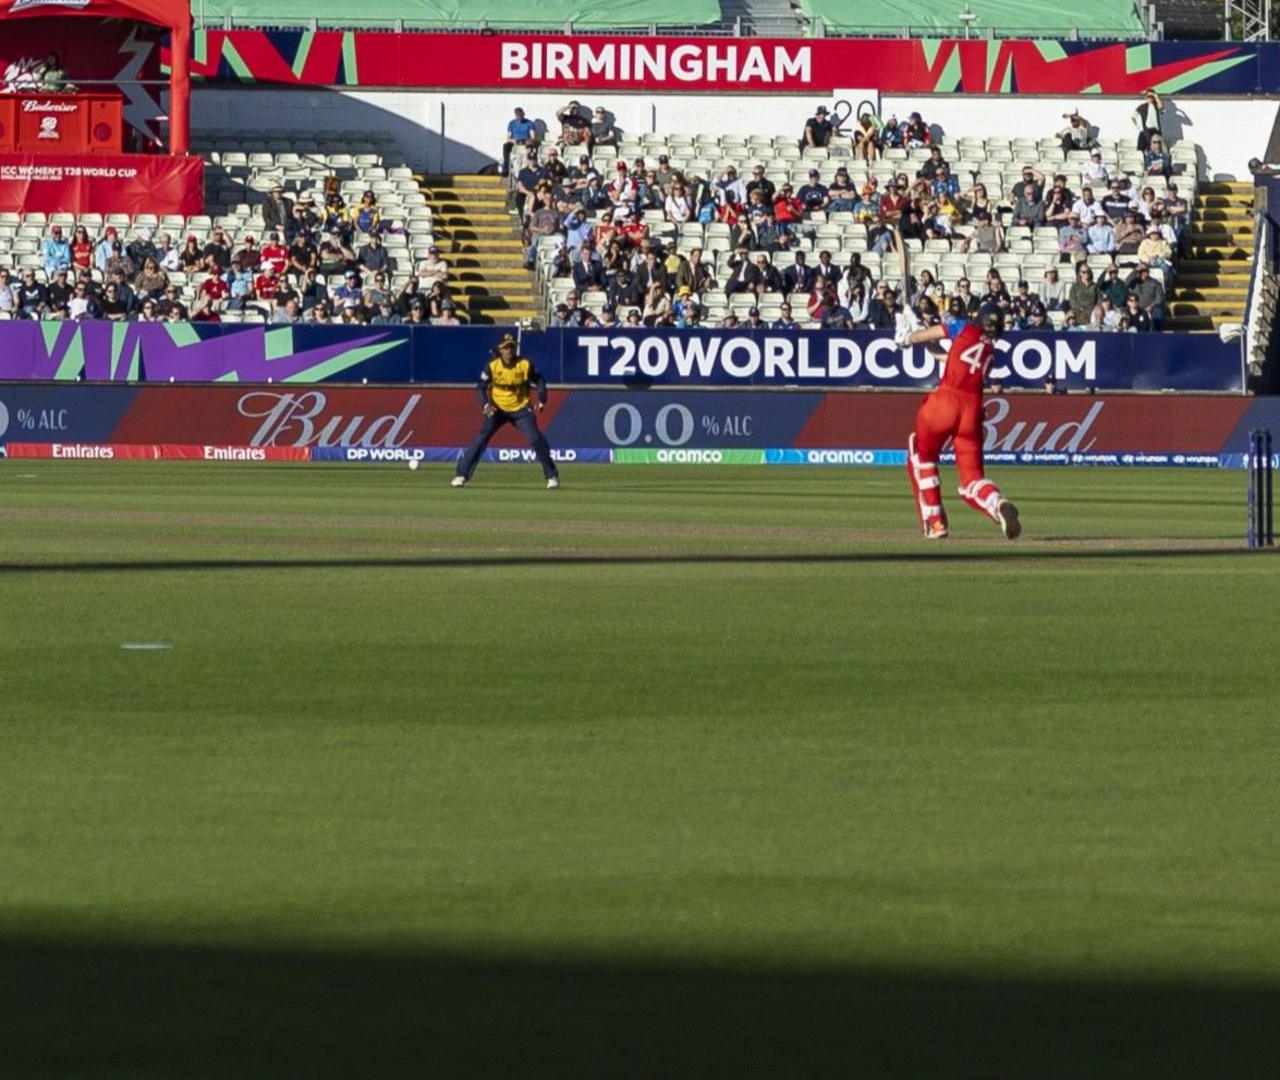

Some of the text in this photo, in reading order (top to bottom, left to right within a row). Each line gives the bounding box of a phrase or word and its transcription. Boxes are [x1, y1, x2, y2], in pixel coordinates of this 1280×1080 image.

[501, 42, 811, 83] BIRMINGHAM
[21, 98, 78, 115] Budweiser
[834, 100, 876, 132] 20
[0, 166, 138, 178] ICC WOMEN'S T20 WORLD CUP
[578, 336, 1097, 381] T20WORLDCUCOM
[17, 410, 36, 430] %
[38, 409, 68, 430] ALC
[237, 391, 422, 448] Bud
[603, 403, 752, 446] 0.0 % ALC
[52, 444, 114, 459] Emirates
[204, 446, 266, 461] Emirates
[347, 448, 425, 461] DP WORLD
[499, 448, 577, 461] DP WRLD
[657, 449, 723, 463] aramco
[808, 450, 874, 464] aramco
